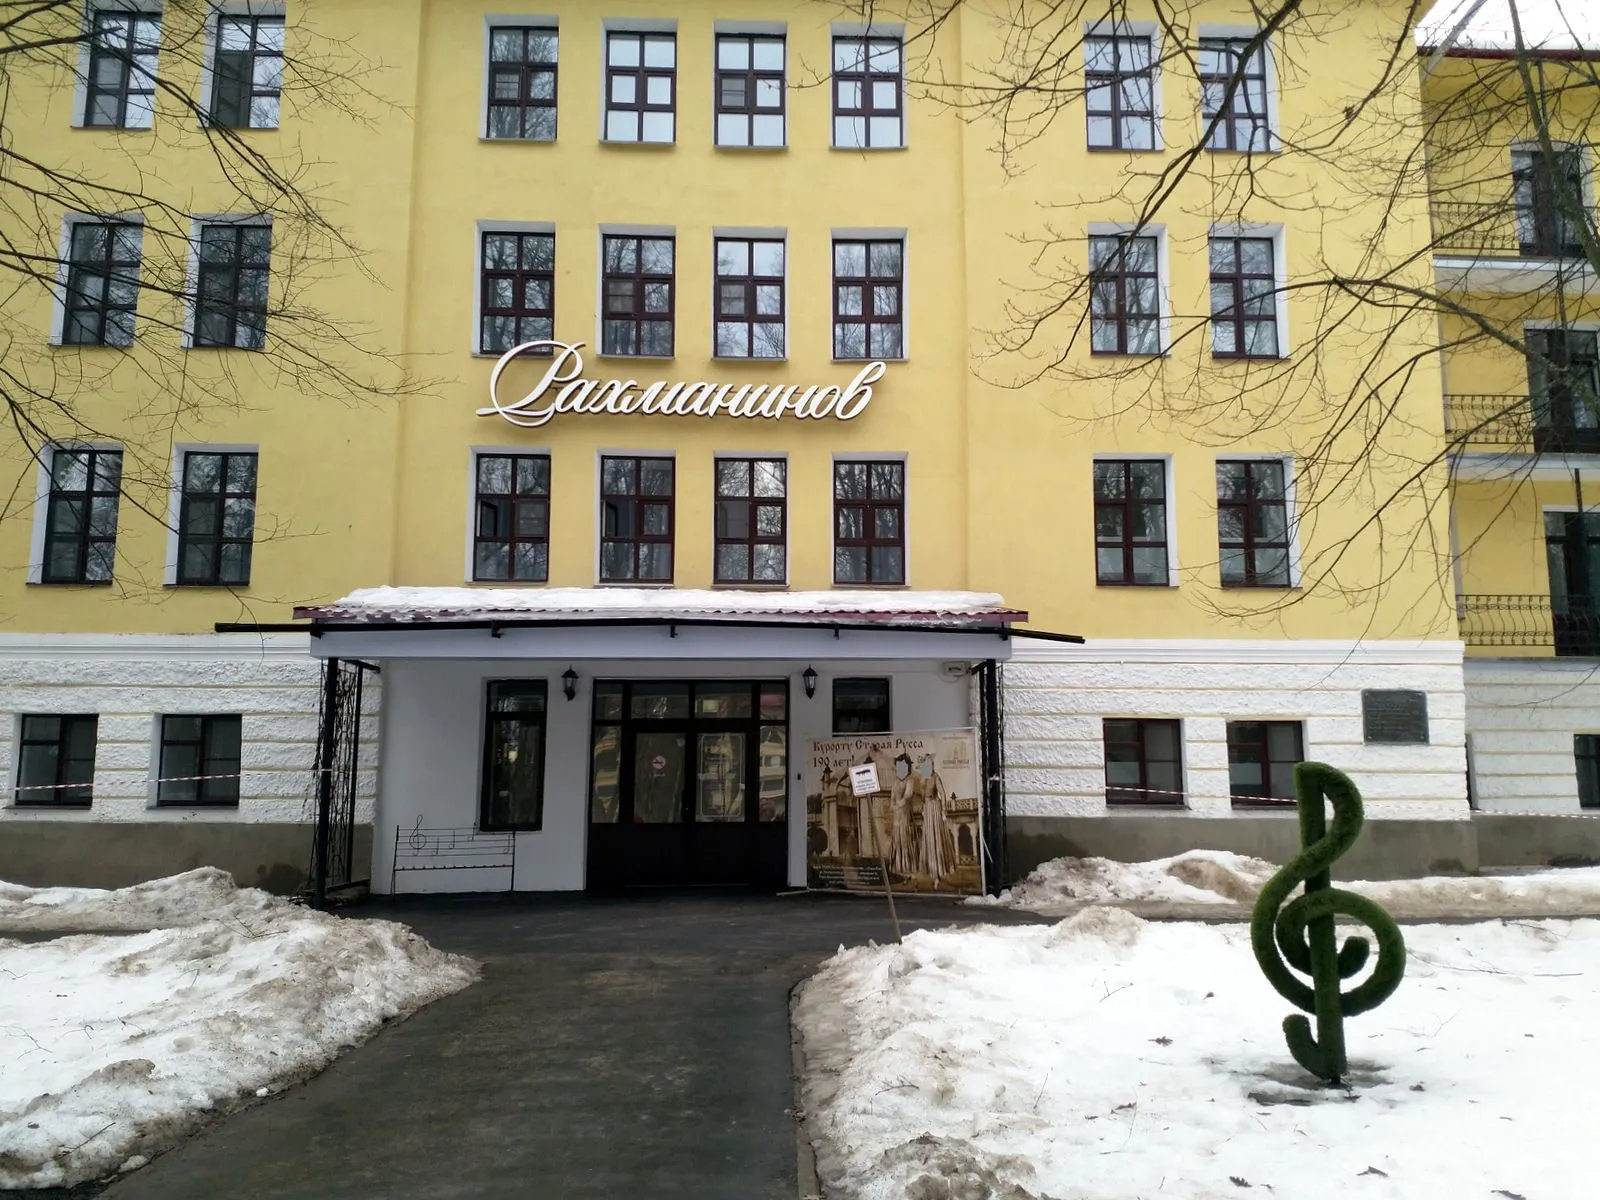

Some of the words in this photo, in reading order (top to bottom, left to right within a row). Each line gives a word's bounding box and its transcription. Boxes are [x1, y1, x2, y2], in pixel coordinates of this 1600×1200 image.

[475, 339, 886, 428] Рахманинов
[813, 741, 853, 754] Курорту
[855, 739, 892, 750] Старая
[895, 738, 924, 751] Русса
[813, 756, 829, 768] 190
[833, 754, 855, 768] лет!
